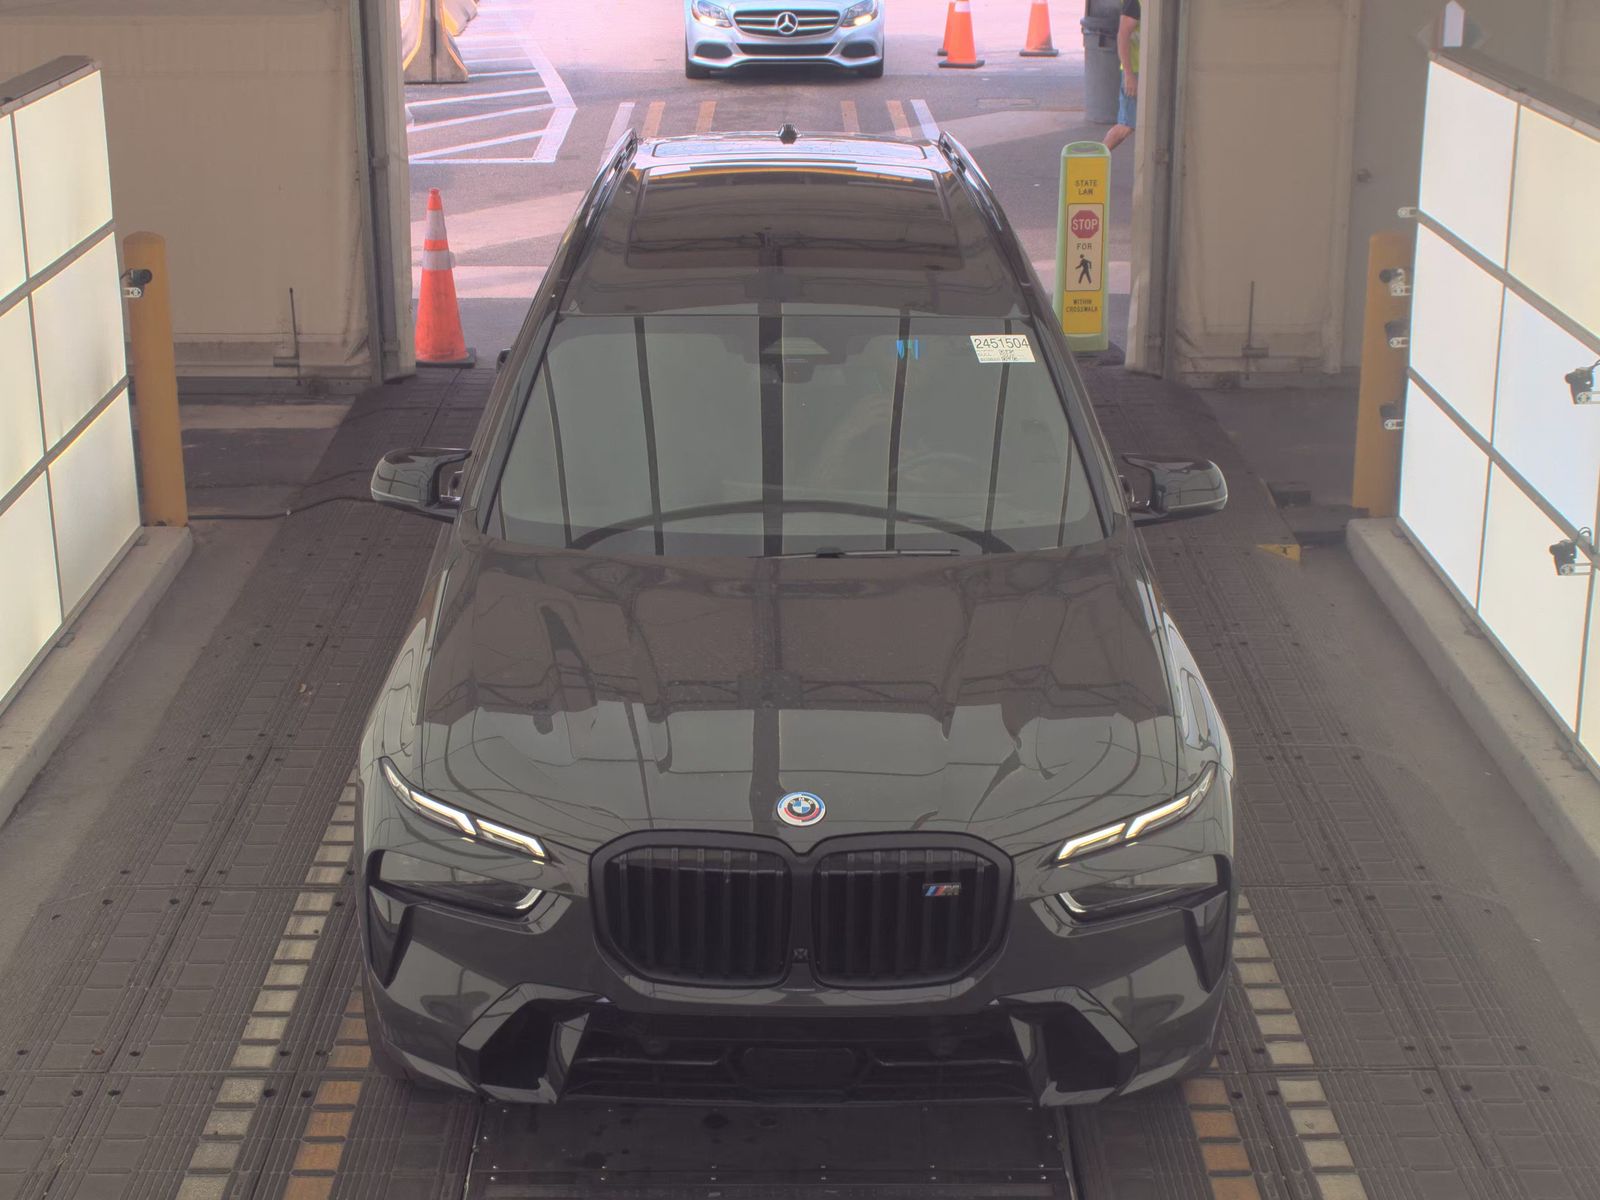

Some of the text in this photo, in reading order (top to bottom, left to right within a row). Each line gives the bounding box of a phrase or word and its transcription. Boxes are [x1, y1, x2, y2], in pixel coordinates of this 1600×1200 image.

[1075, 179, 1098, 188] STATE
[1072, 218, 1098, 231] STOP
[1076, 242, 1093, 250] FOR
[974, 337, 1030, 349] 2451504
